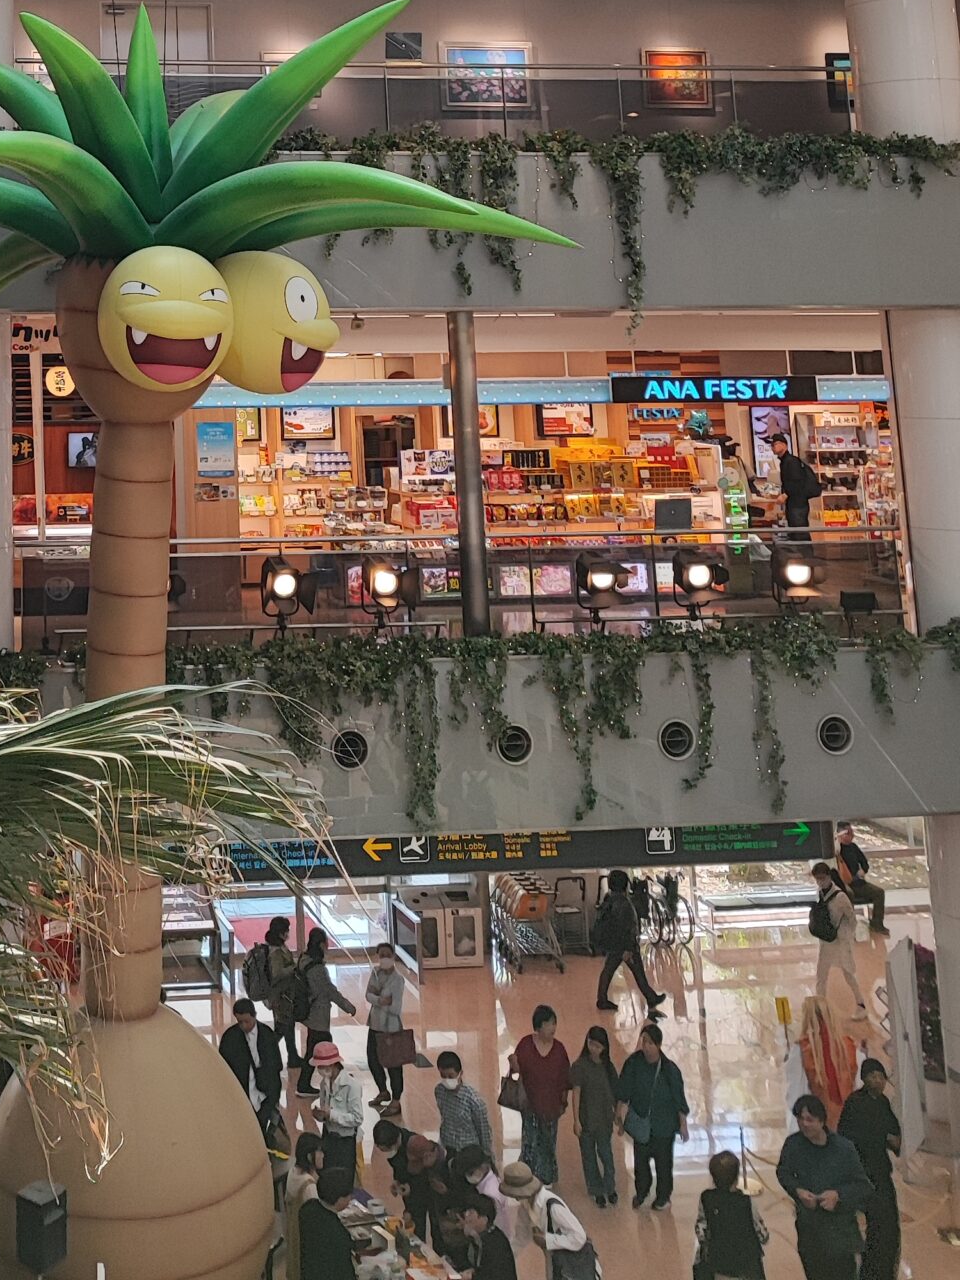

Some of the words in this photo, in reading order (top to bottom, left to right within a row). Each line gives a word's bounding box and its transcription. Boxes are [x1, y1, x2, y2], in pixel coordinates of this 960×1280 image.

[644, 379, 700, 400] ANA
[704, 379, 788, 400] FESTA
[634, 407, 682, 420] FESTA
[437, 842, 461, 851] Arrival
[464, 841, 487, 851] Lobby
